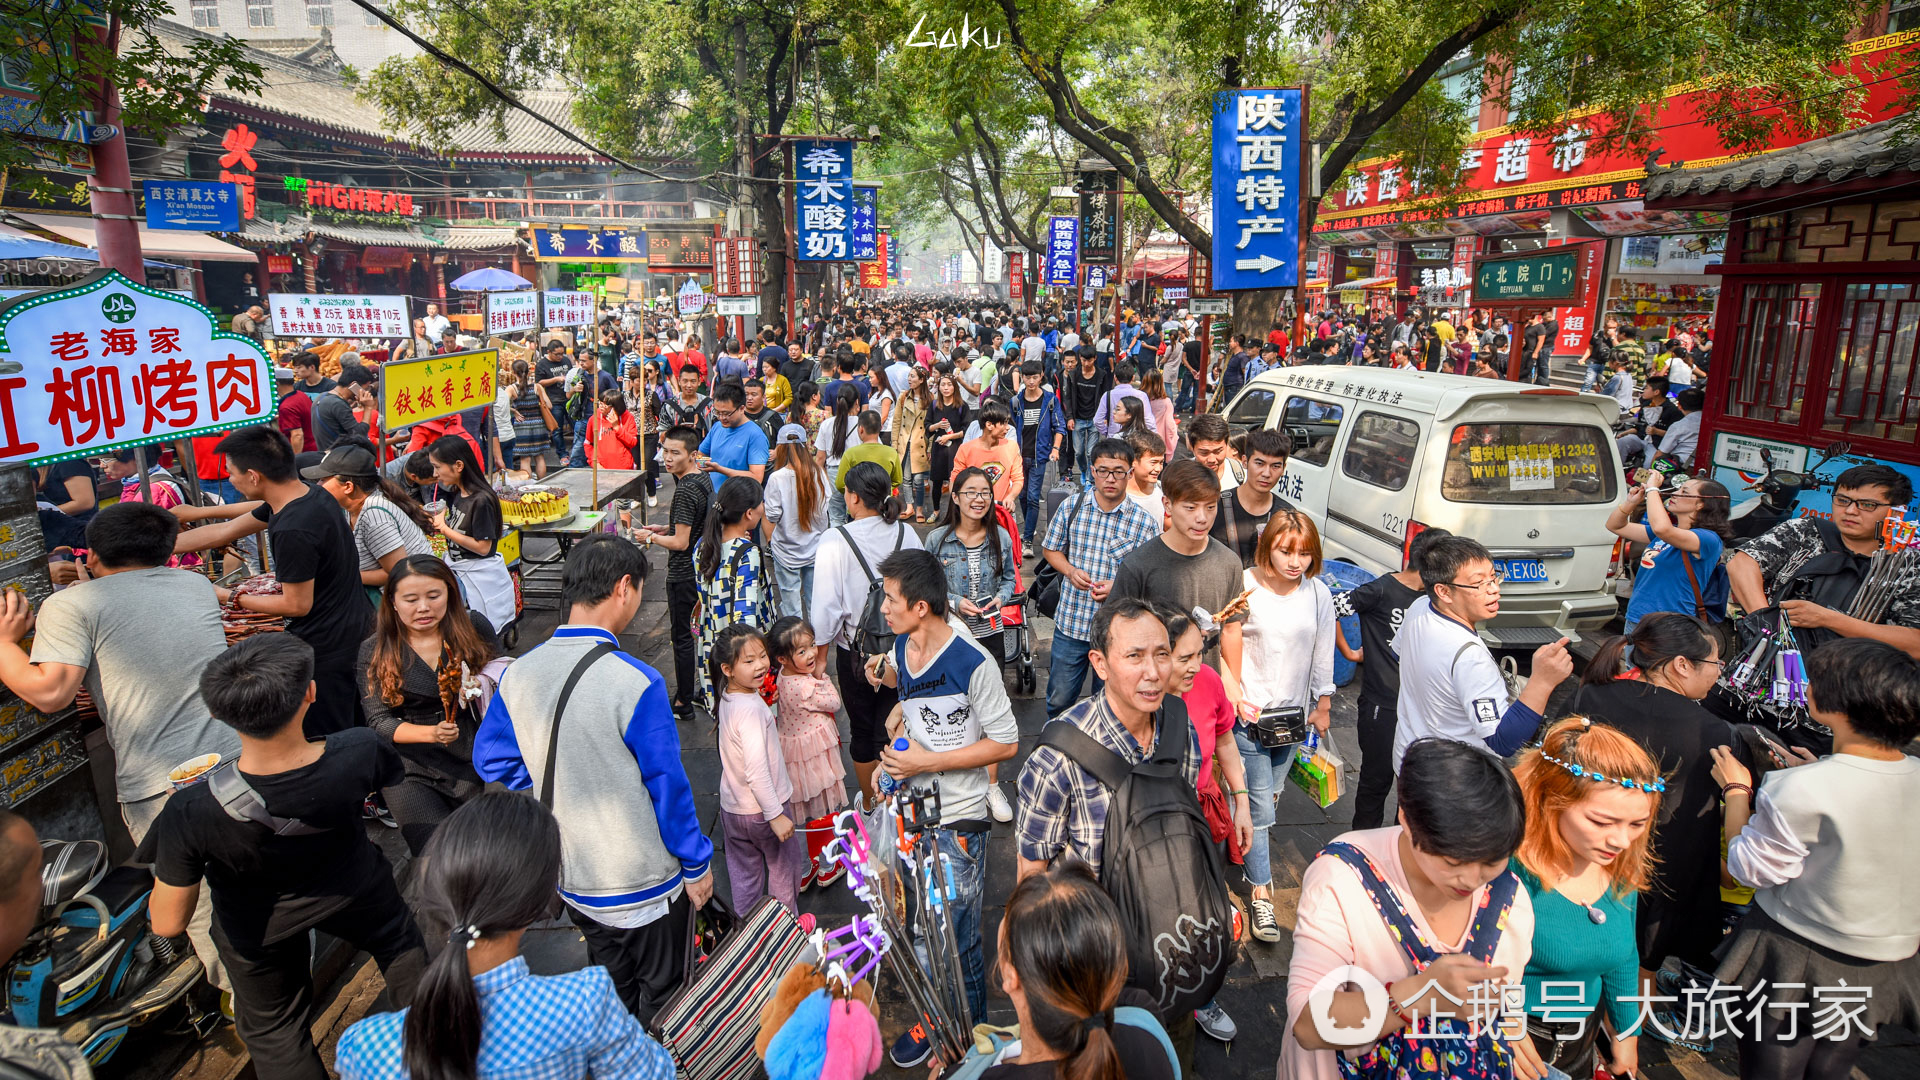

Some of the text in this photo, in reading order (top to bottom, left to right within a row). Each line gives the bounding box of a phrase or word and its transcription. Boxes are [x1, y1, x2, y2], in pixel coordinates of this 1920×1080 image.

[1236, 95, 1286, 250] 陕西特产
[1346, 124, 1592, 207] 陕西超市
[150, 187, 230, 203] 西安清真大寺
[802, 148, 846, 258] 希木酸奶
[550, 233, 640, 255] 希木酸
[1052, 220, 1074, 279] 陕西特产总汇
[1421, 267, 1467, 286] 老酸奶
[1497, 263, 1552, 283] 北院门
[1532, 284, 1545, 293] MEN
[51, 327, 182, 361] 老海家
[393, 371, 492, 417] 铁板香豆腐
[1342, 383, 1403, 405] 标准化执法
[1279, 471, 1304, 501] 执法
[1382, 513, 1403, 535] 1221
